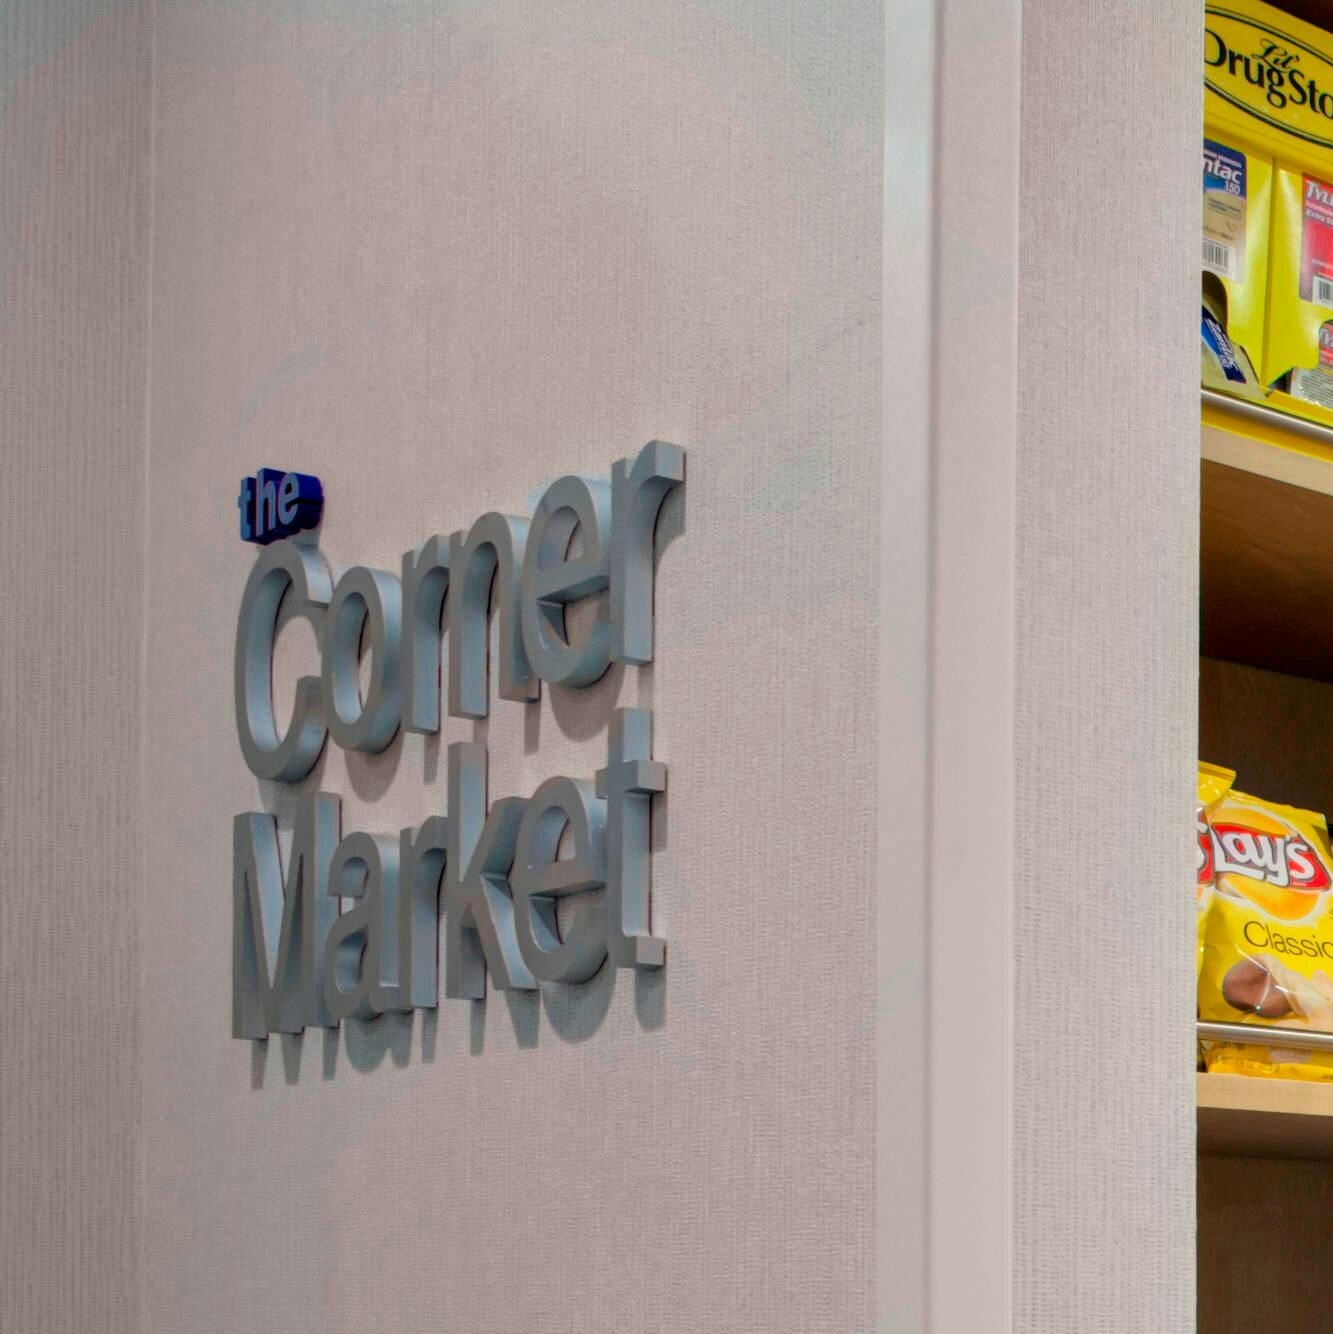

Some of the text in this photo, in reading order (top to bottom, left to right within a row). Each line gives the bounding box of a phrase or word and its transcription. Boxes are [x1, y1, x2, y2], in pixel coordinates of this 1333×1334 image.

[1203, 158, 1242, 185] ntac
[1224, 181, 1241, 196] 150
[237, 467, 324, 542] the
[234, 440, 687, 783] Corner
[232, 706, 667, 1040] Market
[1208, 826, 1316, 888] Lay's
